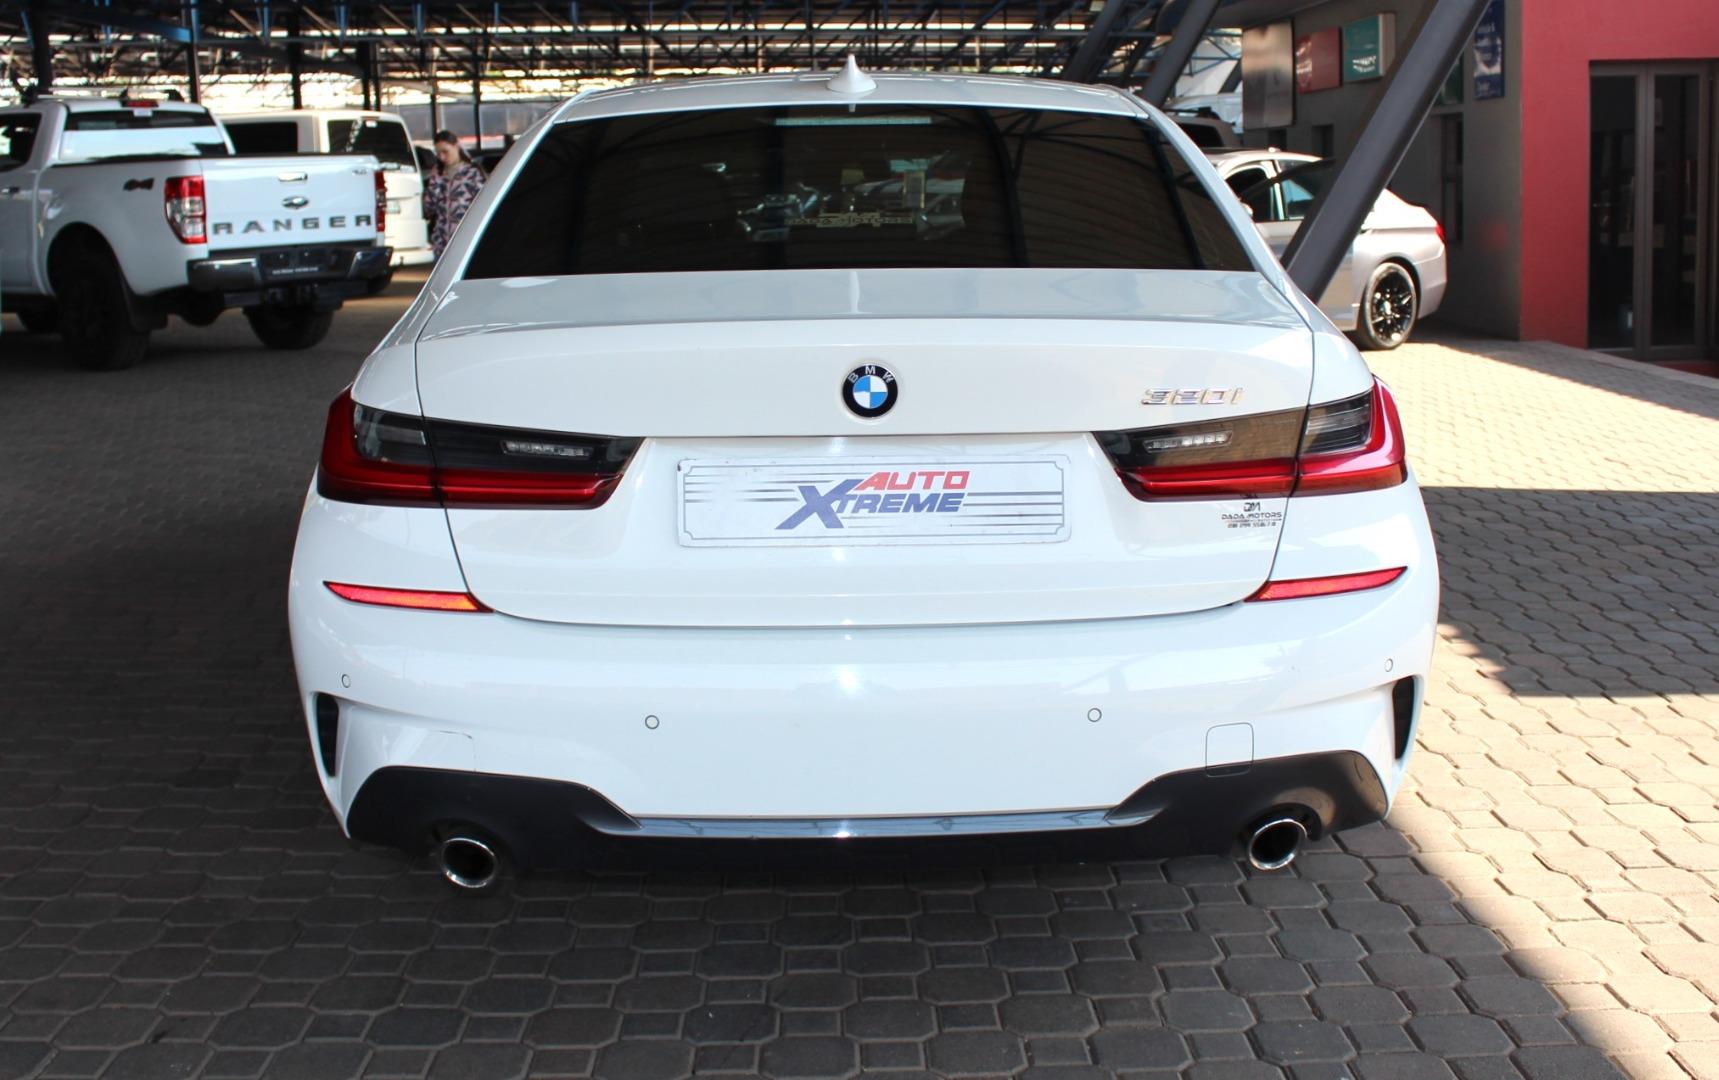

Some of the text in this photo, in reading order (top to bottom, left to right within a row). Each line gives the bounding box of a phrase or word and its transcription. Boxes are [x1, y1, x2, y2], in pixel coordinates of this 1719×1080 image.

[212, 214, 372, 235] RANGER
[848, 365, 895, 384] BMW
[1141, 386, 1244, 405] 320i
[855, 471, 971, 491] AUTO
[774, 479, 966, 530] XTREME
[1246, 511, 1282, 519] MOTORS
